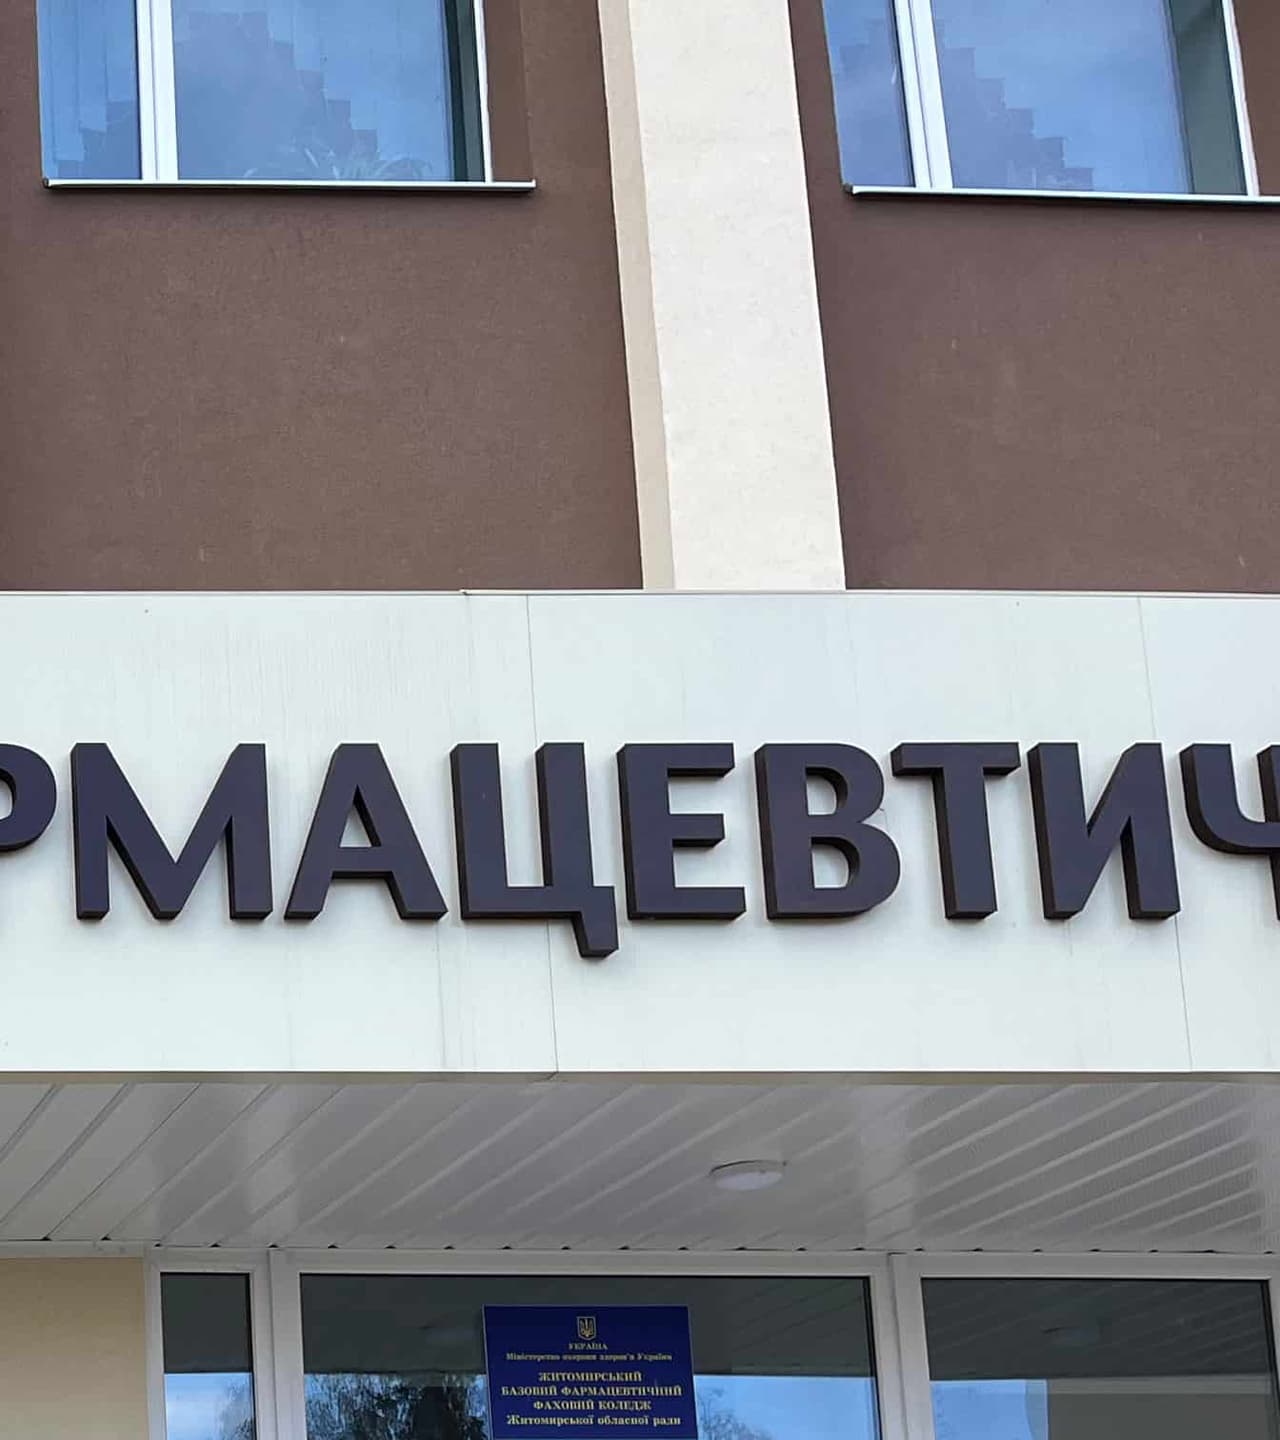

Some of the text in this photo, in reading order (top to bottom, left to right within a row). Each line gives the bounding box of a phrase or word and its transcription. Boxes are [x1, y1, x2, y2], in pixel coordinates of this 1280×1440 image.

[538, 1371, 642, 1382] ЖИТОМИРСЬКИЙ
[501, 1384, 682, 1396] БАЗОВИЙ ФАРМАЦЕВТИЧНИЙ
[533, 1398, 652, 1412] ФАХОВИЙ КОЛЕДЖ
[506, 1414, 681, 1427] Житомирської обласної ради
